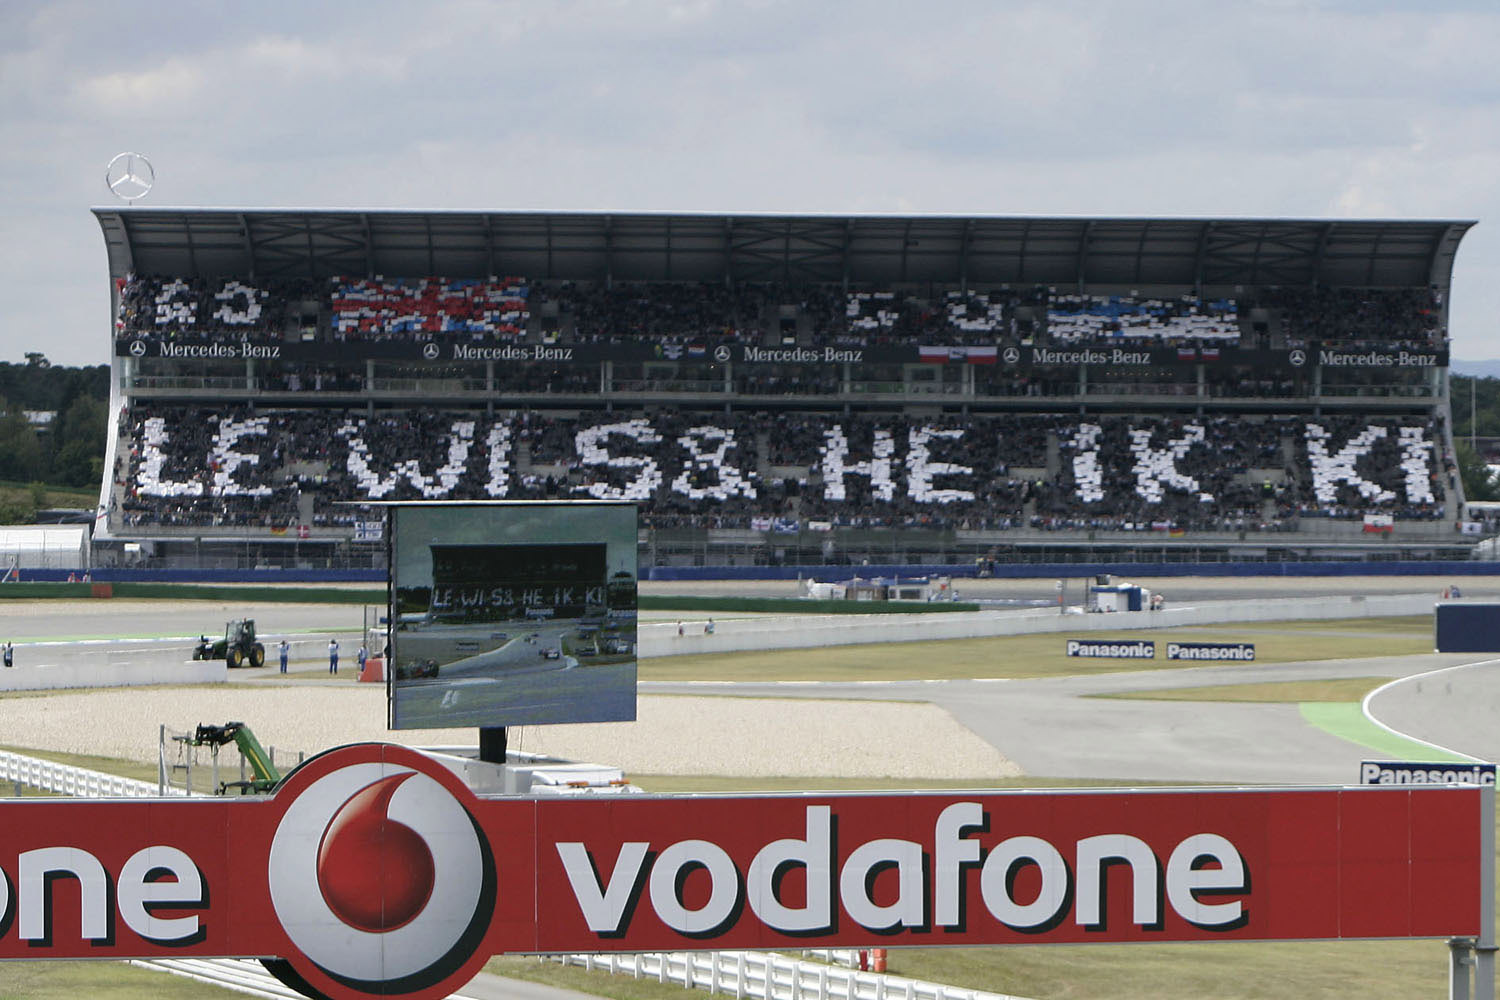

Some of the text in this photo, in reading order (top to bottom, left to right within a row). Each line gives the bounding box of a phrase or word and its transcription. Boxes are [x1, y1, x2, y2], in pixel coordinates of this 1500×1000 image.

[160, 342, 281, 358] Mercedes-Benz
[453, 344, 573, 361] Mercedes-Benz
[744, 346, 863, 362] Mercedes-Benz
[1032, 348, 1151, 365] Mercedes-Benz
[1319, 350, 1437, 367] Mercedes-Benz
[1067, 641, 1154, 658] Panasonic
[1167, 643, 1255, 660] Panasonic
[1361, 763, 1495, 786] Panasonic
[555, 801, 1250, 939] vodafone
[0, 845, 206, 947] ne
